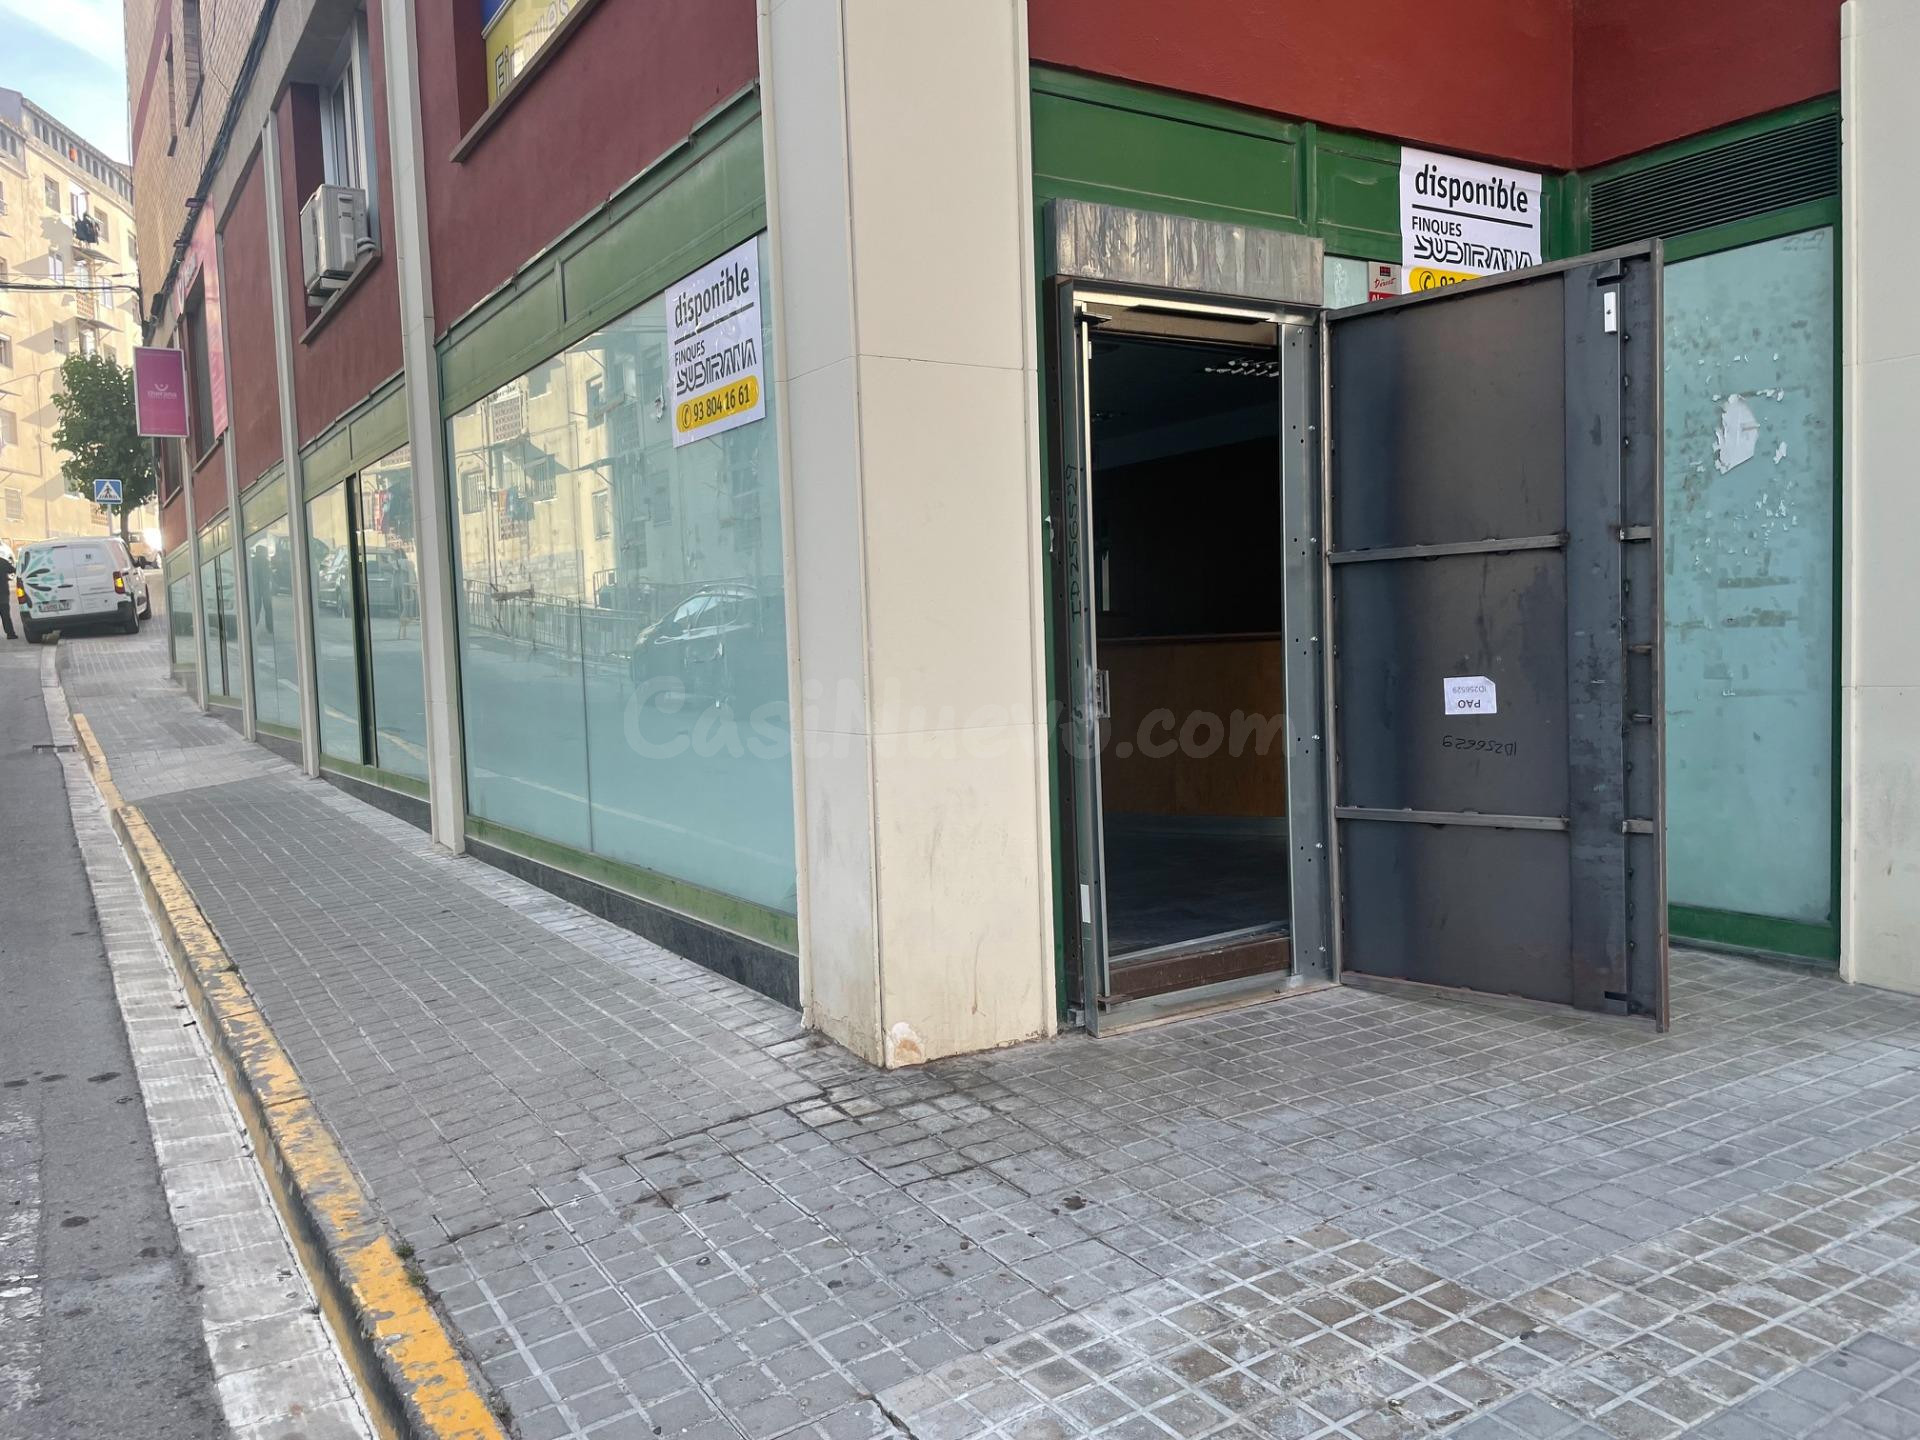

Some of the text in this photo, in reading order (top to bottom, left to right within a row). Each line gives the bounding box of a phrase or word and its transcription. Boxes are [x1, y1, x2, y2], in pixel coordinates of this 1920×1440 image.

[1415, 164, 1528, 213] disponible
[1412, 216, 1462, 237] FINQUES
[1413, 234, 1533, 271] SUBIRANA
[674, 262, 750, 329] disponible
[674, 340, 706, 367] FINQUES
[676, 338, 758, 396] SUBIRANA
[693, 383, 750, 422] 93 804 16 61
[1065, 464, 1082, 622] ID256529
[1457, 699, 1481, 709] PAO
